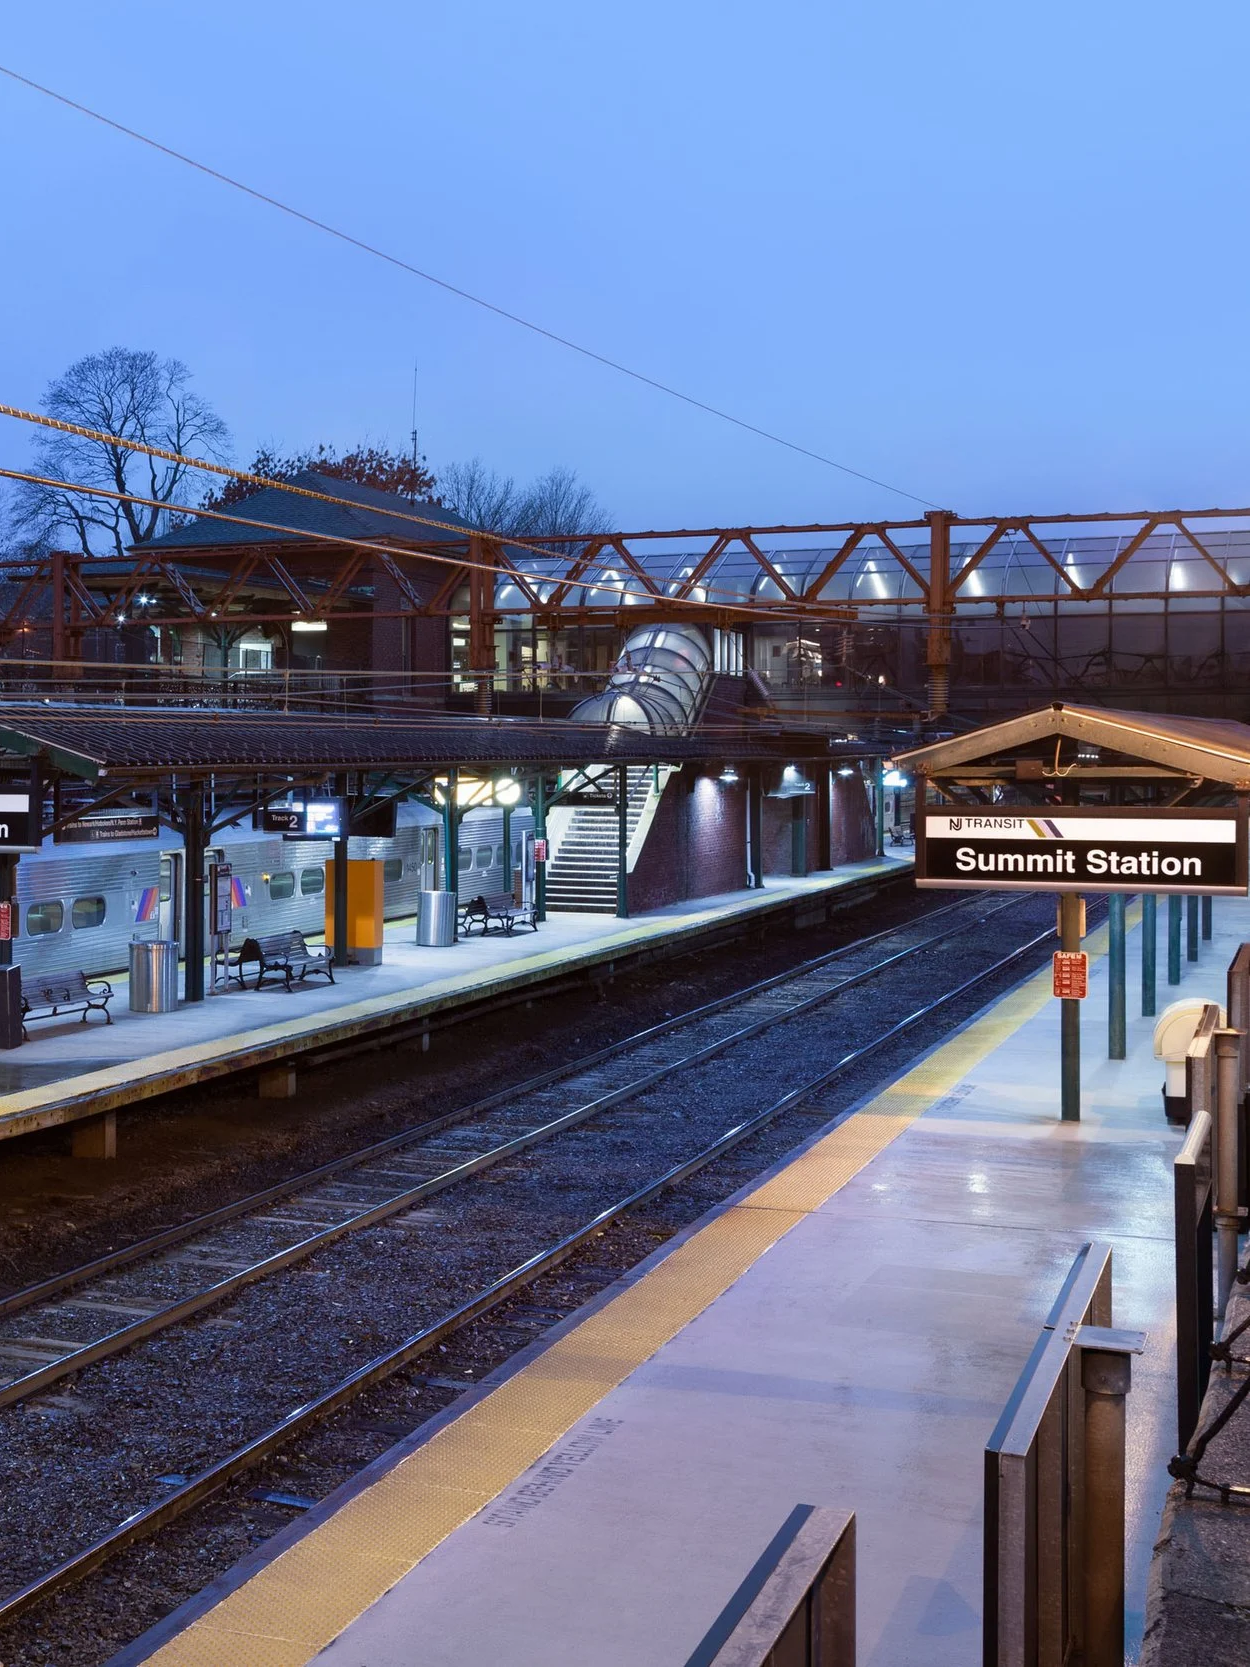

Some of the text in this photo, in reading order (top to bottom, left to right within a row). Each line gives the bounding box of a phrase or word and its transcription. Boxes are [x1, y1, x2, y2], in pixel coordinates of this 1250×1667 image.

[804, 782, 811, 790] 2
[288, 815, 298, 828] 2
[964, 818, 1025, 829] TRANSIT
[956, 847, 1202, 876] Summit Station
[548, 1433, 606, 1466] YELLOW
[584, 1417, 625, 1435] LINE
